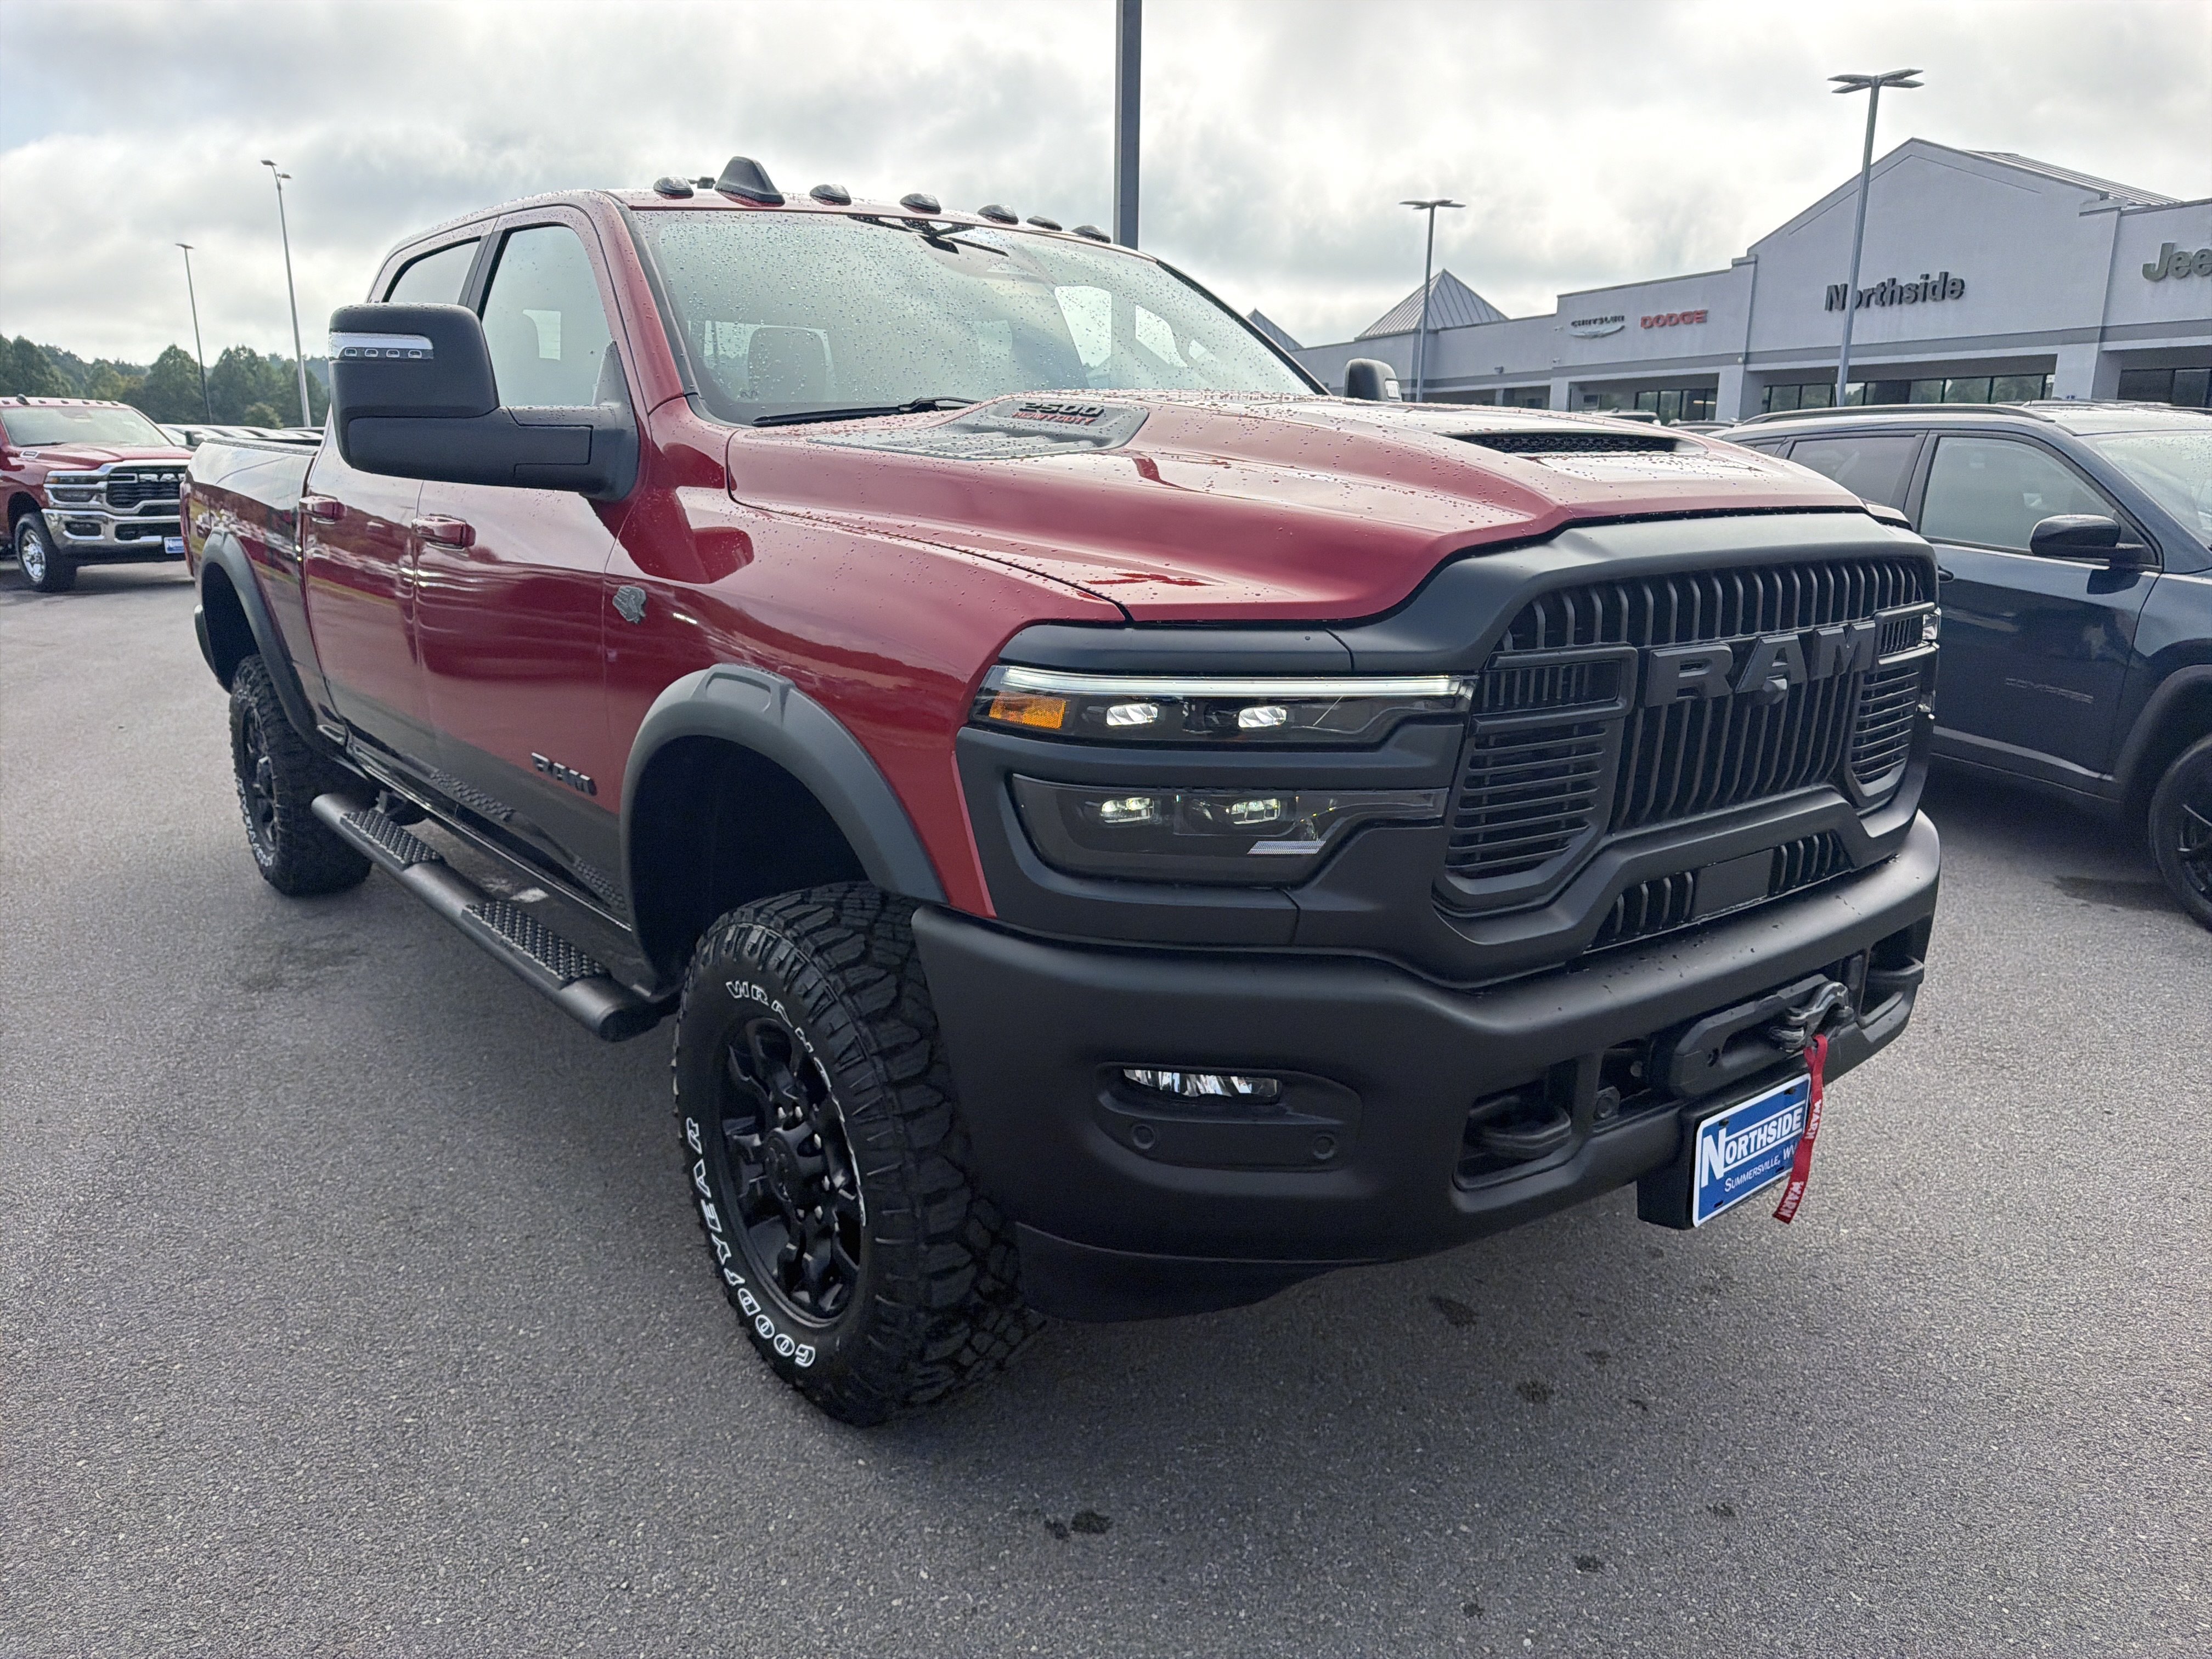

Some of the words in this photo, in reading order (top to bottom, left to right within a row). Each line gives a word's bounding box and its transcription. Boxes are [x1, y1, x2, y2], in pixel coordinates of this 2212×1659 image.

[1824, 272, 1965, 312] Northside
[1640, 309, 1708, 329] DODGE
[1018, 402, 1104, 417] 2500
[1645, 621, 1876, 708] RAM
[1804, 1099, 1822, 1139] WARN
[1701, 1107, 1803, 1189] NORTHSIDE
[1778, 1181, 1804, 1217] WARN
[687, 1117, 817, 1367] GOODYEAR
